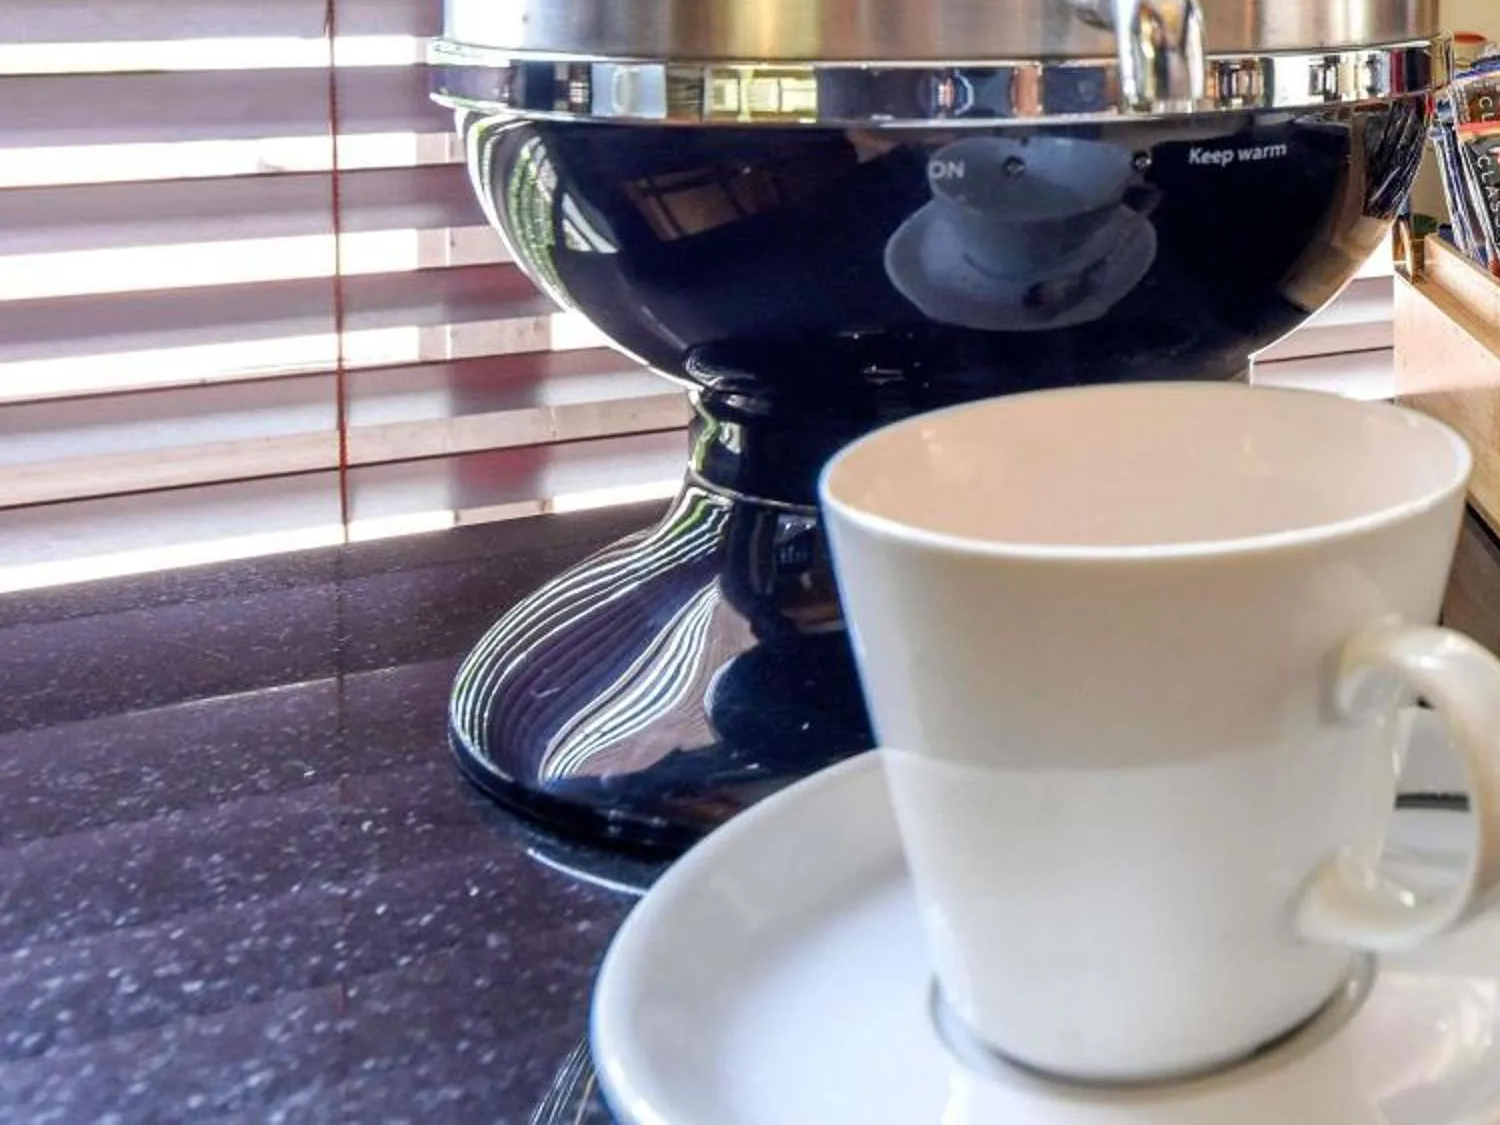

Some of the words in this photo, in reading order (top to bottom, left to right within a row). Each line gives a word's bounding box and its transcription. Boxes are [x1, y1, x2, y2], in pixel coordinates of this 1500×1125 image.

[1188, 147, 1235, 168] Keep
[1237, 144, 1287, 162] warm
[927, 160, 965, 178] ON
